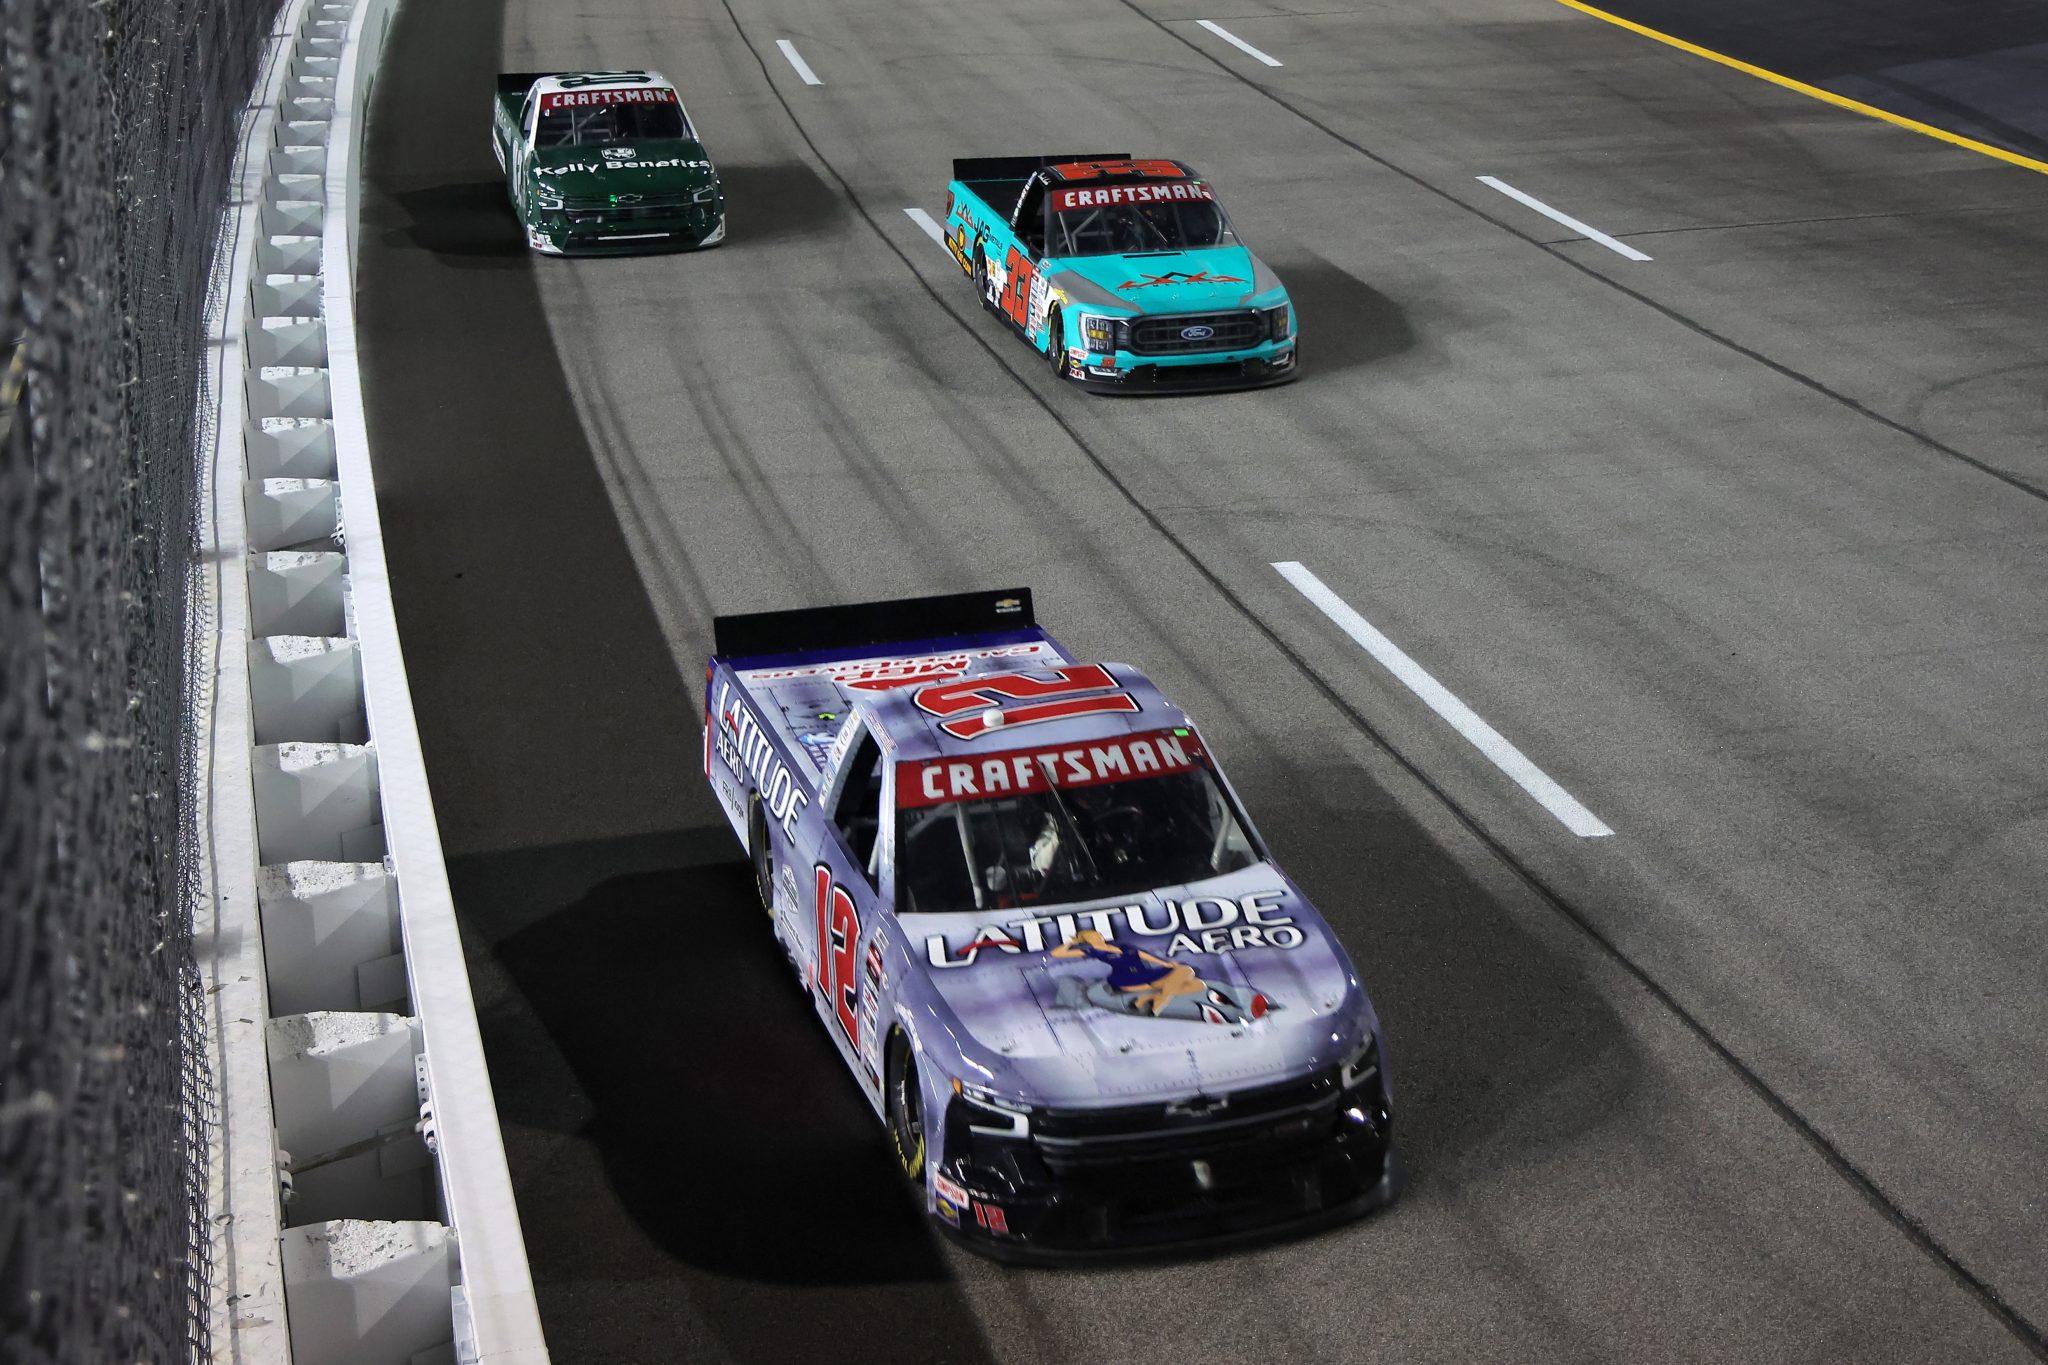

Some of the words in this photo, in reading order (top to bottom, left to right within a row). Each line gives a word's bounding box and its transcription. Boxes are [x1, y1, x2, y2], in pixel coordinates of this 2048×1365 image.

[552, 90, 669, 107] CRAFTSMAN
[533, 163, 600, 179] Kelly
[606, 158, 711, 170] Benefits
[1064, 184, 1203, 208] CRAFTSMAN
[1001, 245, 1034, 328] 33
[1187, 328, 1207, 338] Ford
[911, 663, 1144, 742] 12
[715, 731, 745, 786] AERO
[718, 680, 808, 848] LATITUDE
[921, 736, 1192, 800] CRAFTSMAN
[925, 889, 1294, 969] LATITUDE
[1166, 923, 1305, 958] AERO
[815, 861, 863, 1060] 12
